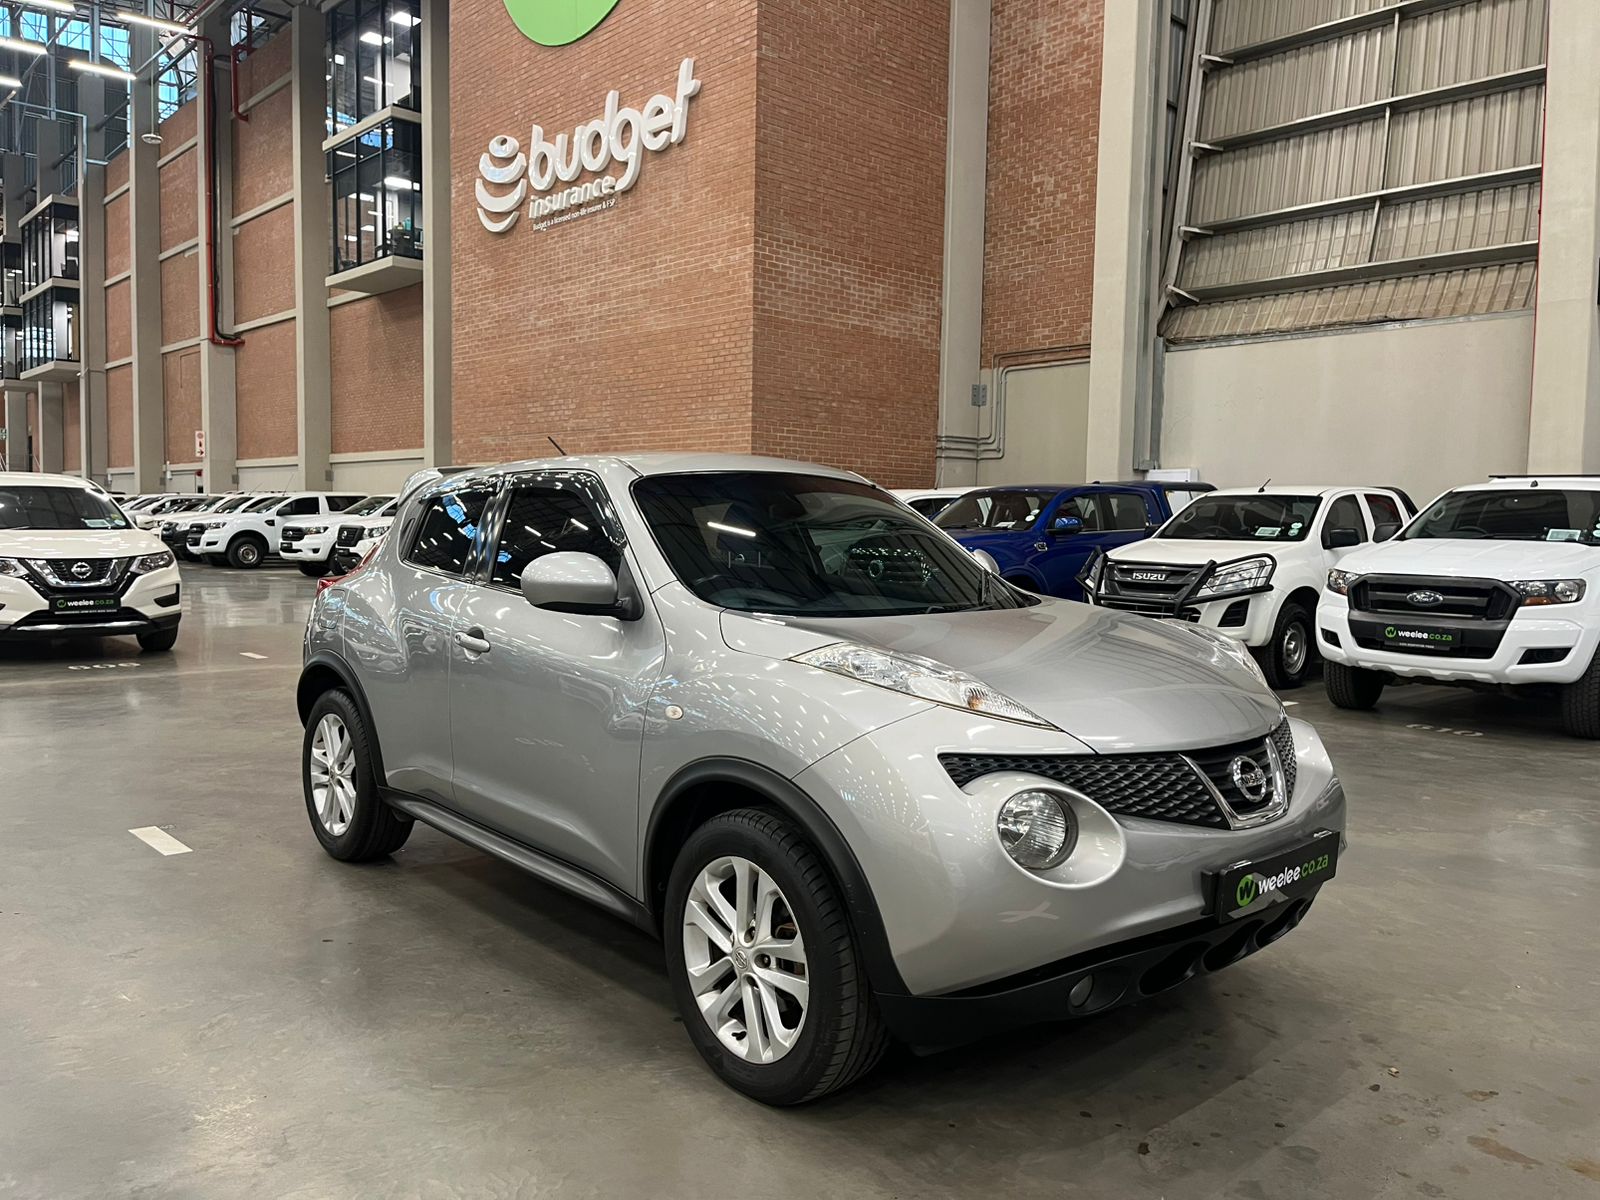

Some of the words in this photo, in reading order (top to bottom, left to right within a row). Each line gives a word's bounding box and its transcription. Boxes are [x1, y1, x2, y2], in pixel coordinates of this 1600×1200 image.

[528, 57, 701, 191] budget
[528, 175, 616, 219] insurance
[1132, 572, 1166, 580] ISUZU
[1397, 629, 1453, 641] weelee.co.za
[1258, 853, 1329, 895] weelee.co.za
